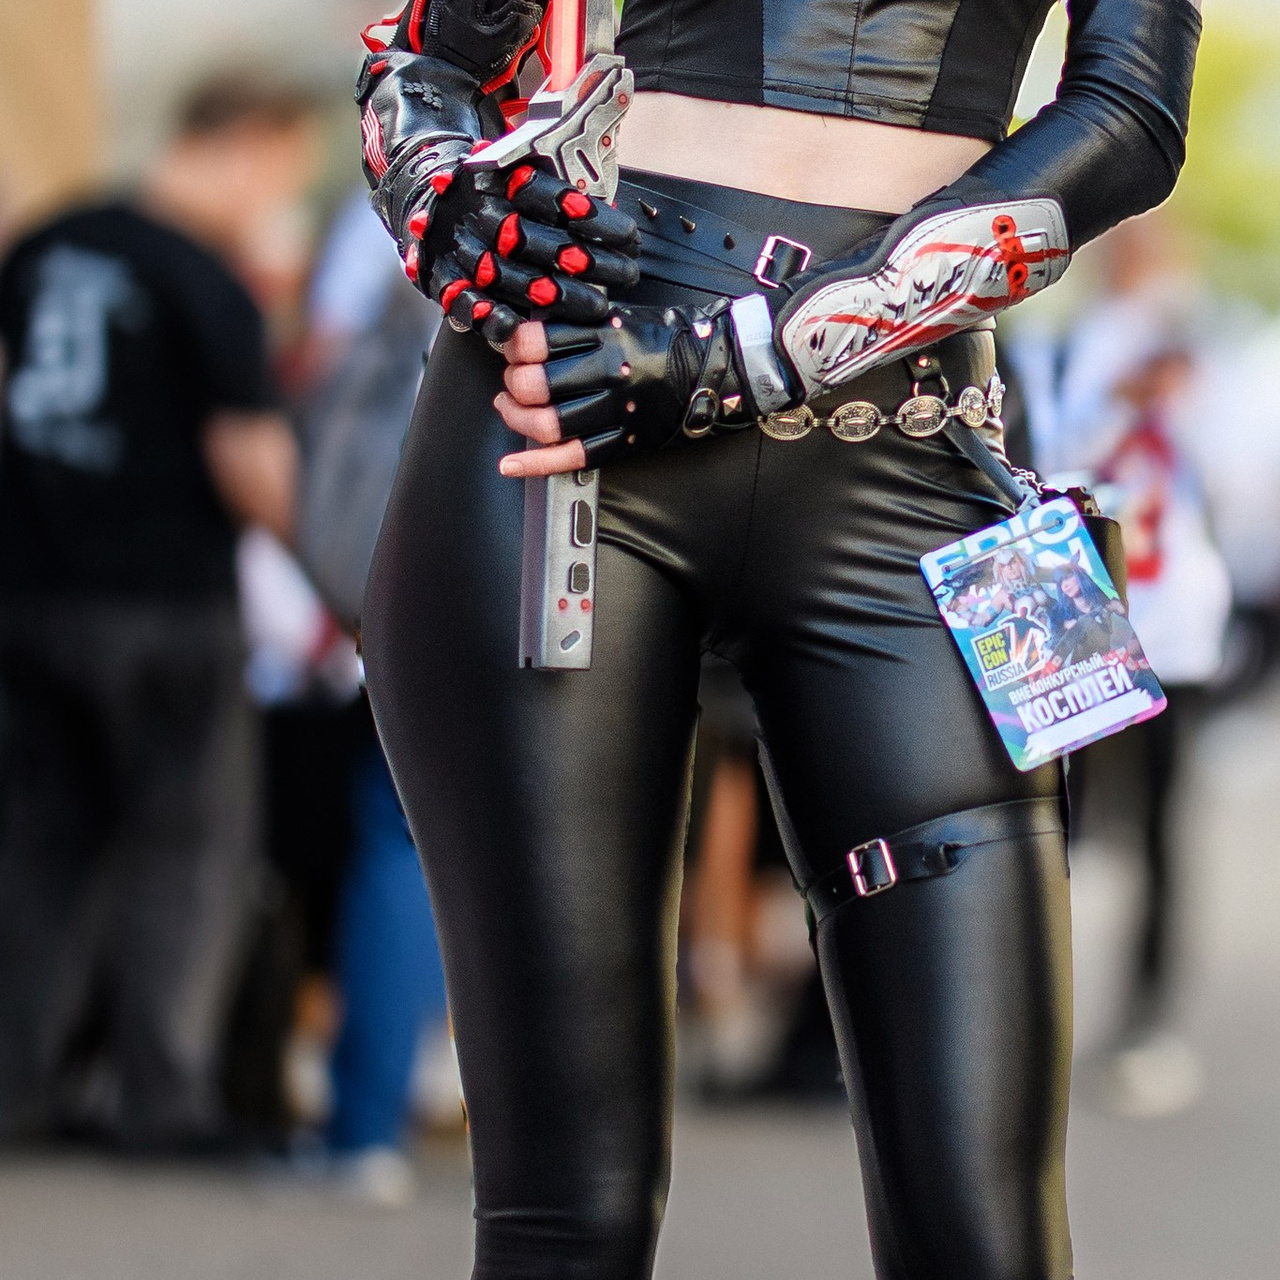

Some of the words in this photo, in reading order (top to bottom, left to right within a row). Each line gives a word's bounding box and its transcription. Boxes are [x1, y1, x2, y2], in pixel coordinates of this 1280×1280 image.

[977, 632, 1006, 656] EPIC
[983, 648, 1008, 670] CON
[987, 662, 1026, 687] RUSSIA
[1009, 651, 1102, 705] ВНЕКОНКУРСНЫЙ
[1017, 657, 1133, 733] КОСПЛЕЙ
